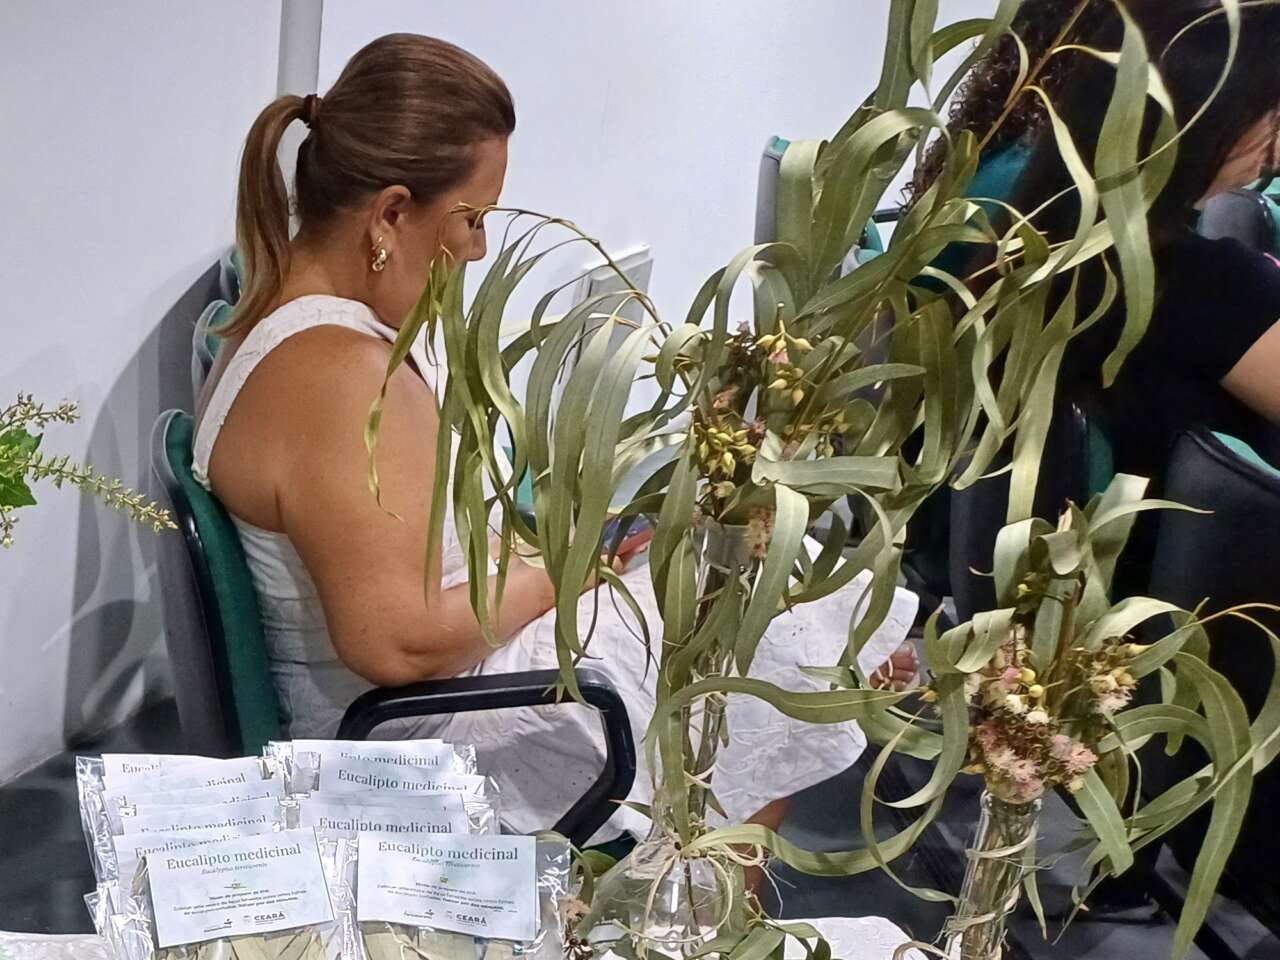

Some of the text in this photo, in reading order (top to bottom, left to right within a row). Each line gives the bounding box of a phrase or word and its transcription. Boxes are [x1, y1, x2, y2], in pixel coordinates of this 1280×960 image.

[338, 769, 468, 792] Eucalipto medici
[319, 817, 453, 835] Eucalipto medicinal
[166, 843, 303, 872] Eucalipto medicinal
[378, 841, 519, 862] Eucalipto medicinal
